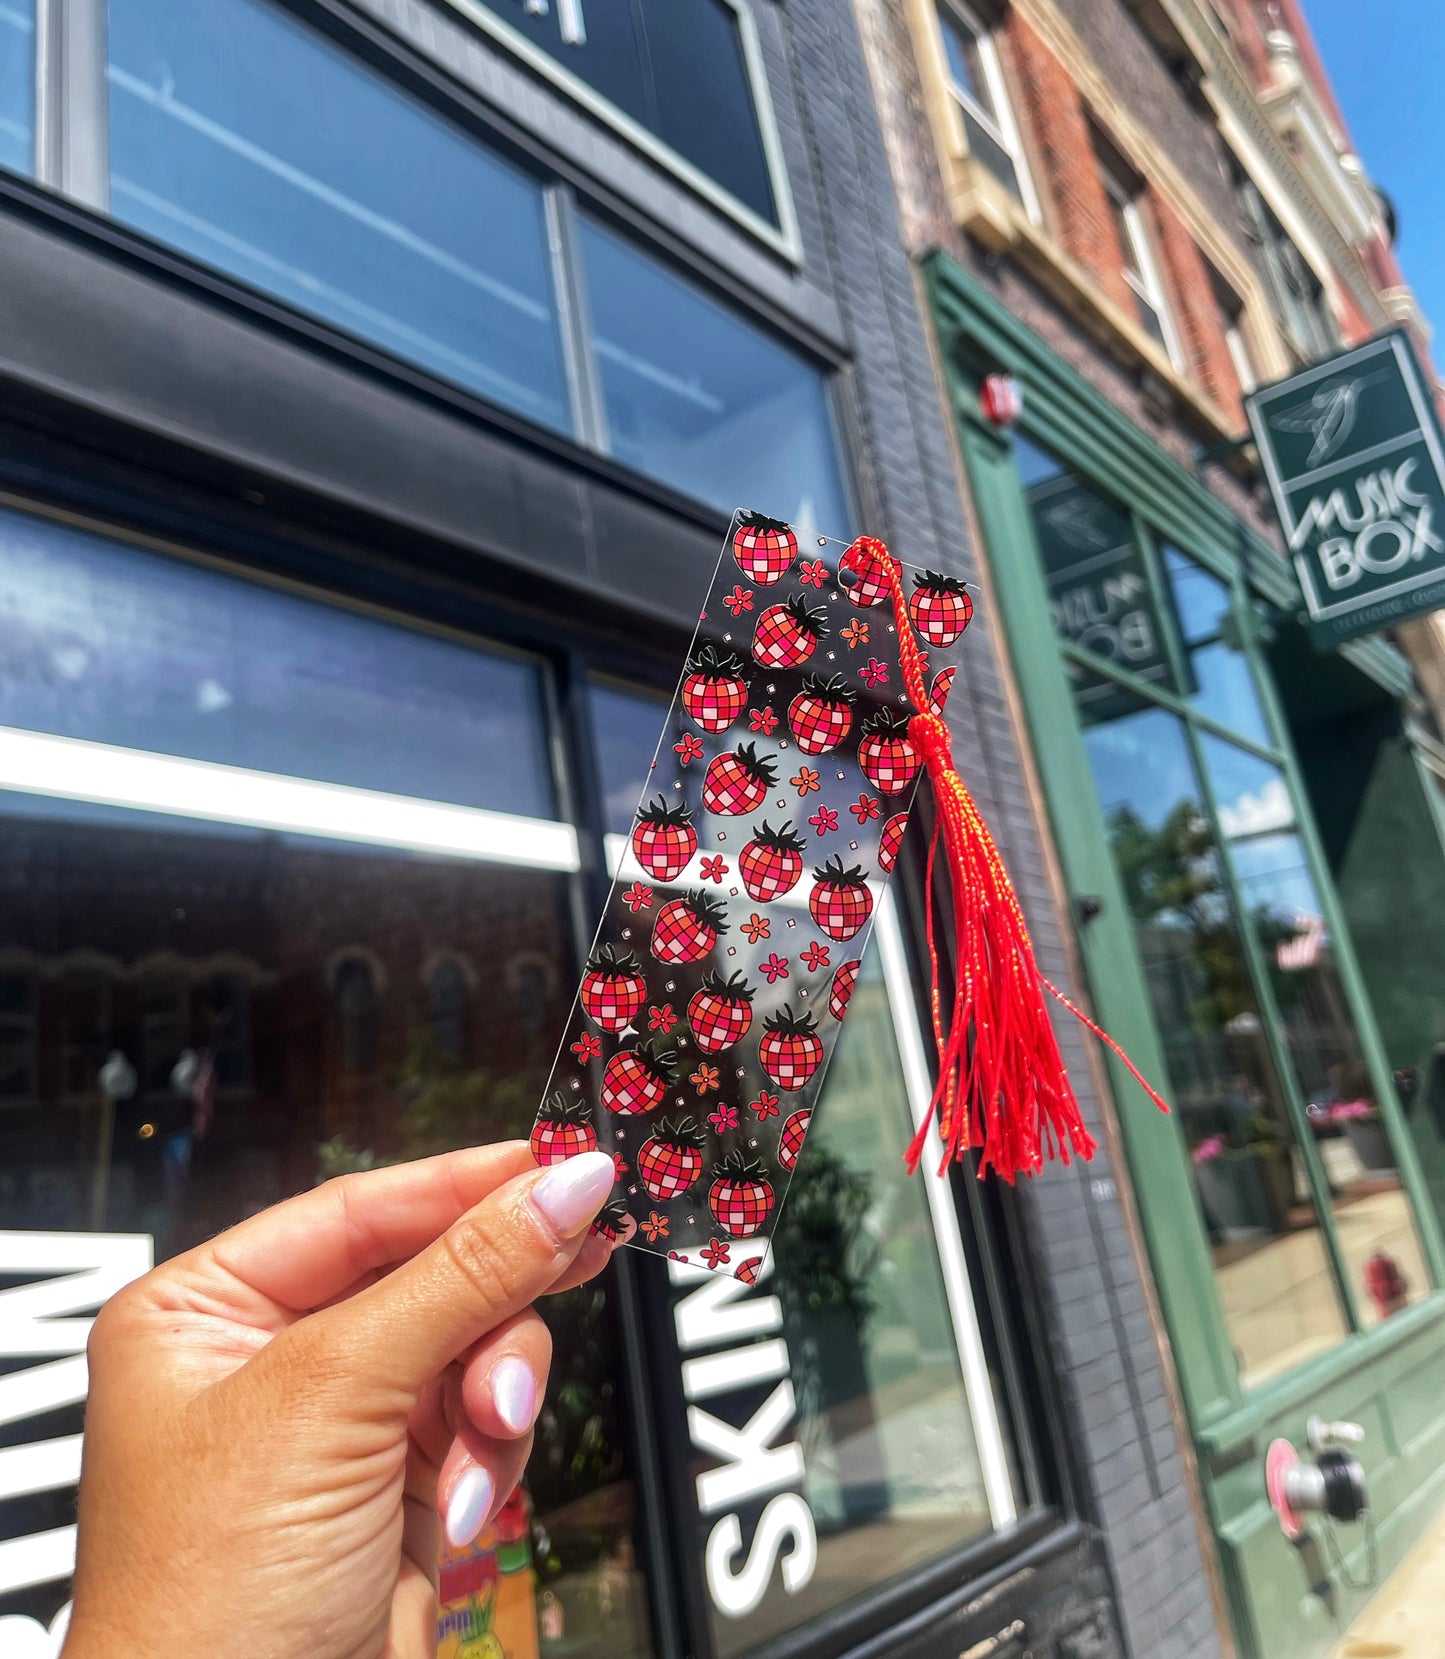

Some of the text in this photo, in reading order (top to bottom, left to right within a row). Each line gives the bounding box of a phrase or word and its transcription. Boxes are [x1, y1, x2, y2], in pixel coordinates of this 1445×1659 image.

[1291, 457, 1430, 550] MUSIC
[1318, 503, 1445, 591] BOX
[666, 1236, 818, 1617] SKIN
